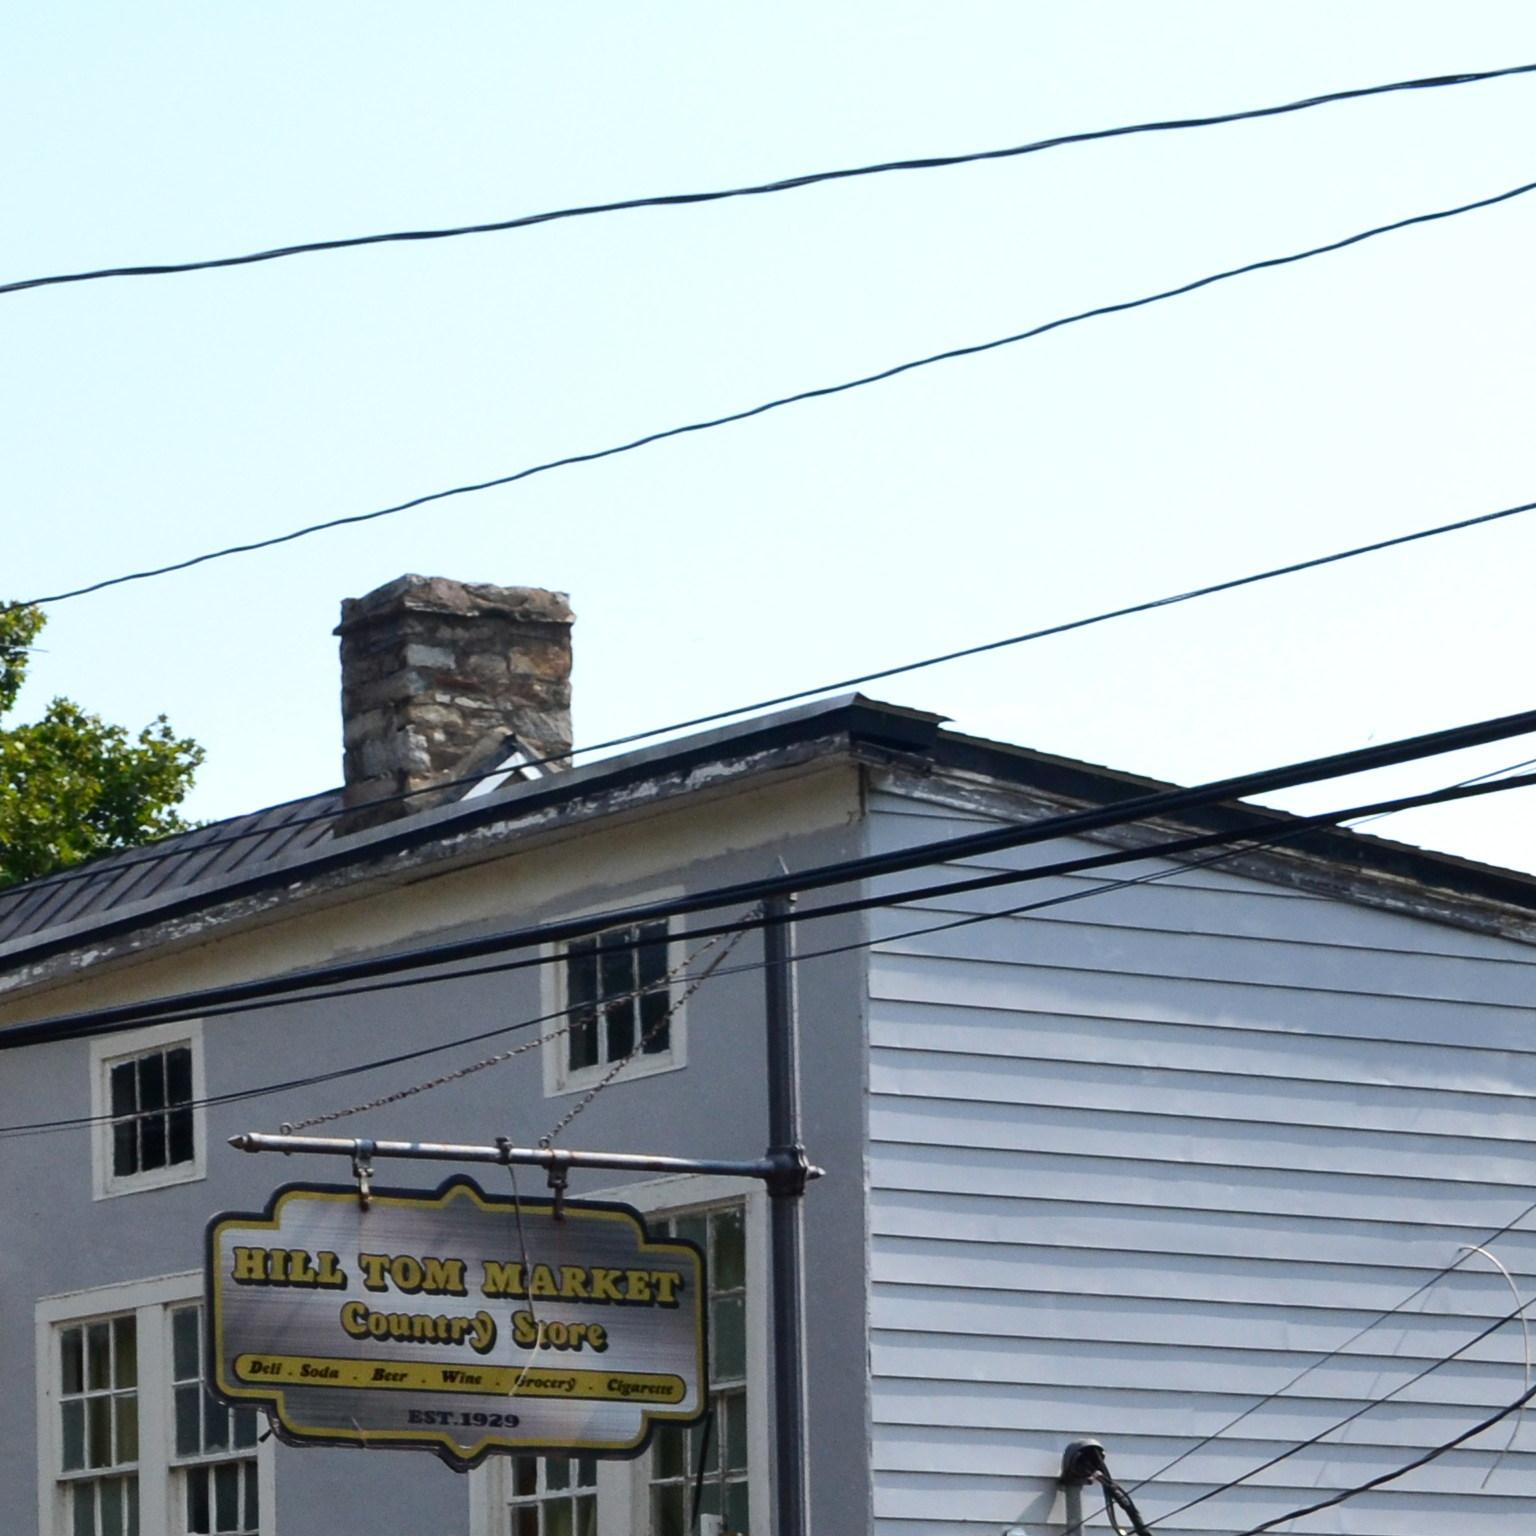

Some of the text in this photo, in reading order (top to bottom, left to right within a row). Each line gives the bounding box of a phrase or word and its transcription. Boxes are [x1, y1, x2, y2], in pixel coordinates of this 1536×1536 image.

[232, 1247, 685, 1309] HILL TOM MARKET
[340, 1301, 609, 1354] Country Store
[249, 1361, 673, 1395] Deli Soda Beer Wine Grocery Cigarette
[408, 1409, 520, 1428] EST.1929
